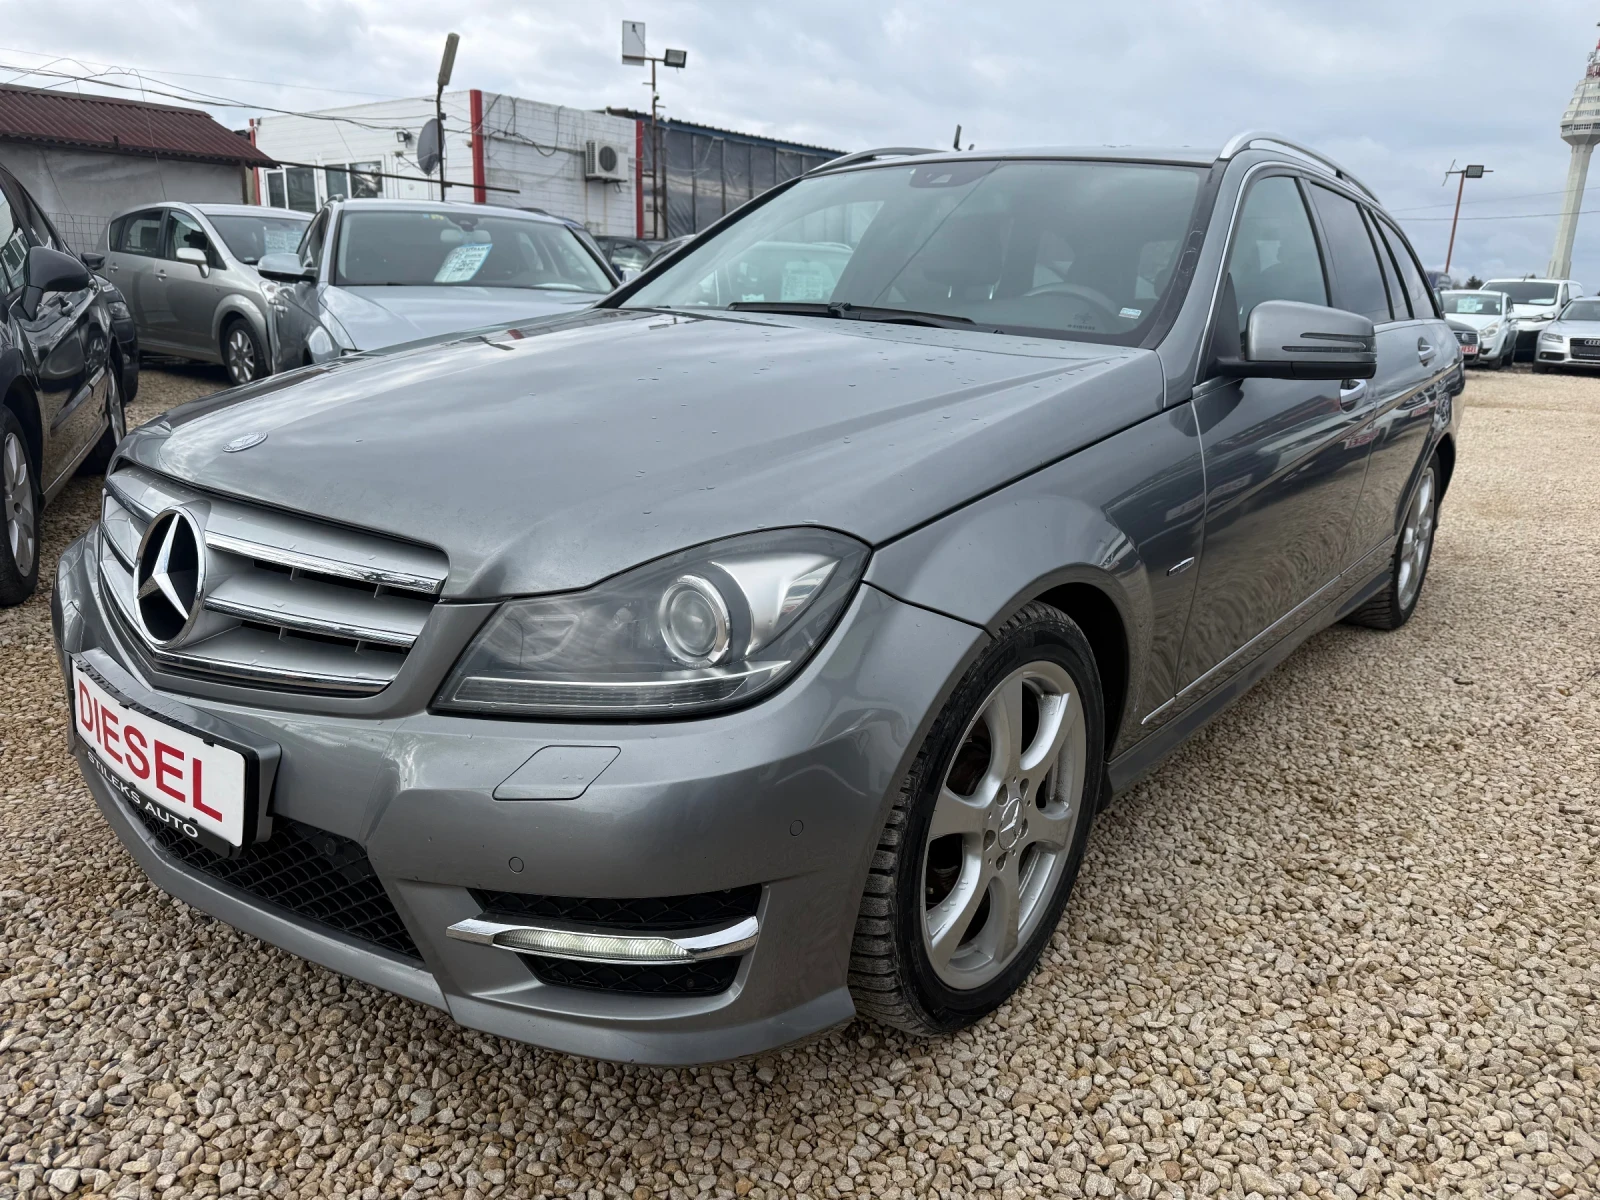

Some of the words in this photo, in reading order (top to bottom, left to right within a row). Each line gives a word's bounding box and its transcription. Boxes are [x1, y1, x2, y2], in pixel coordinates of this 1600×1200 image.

[79, 679, 222, 823] DIESEL
[87, 751, 141, 804] STILEKS
[144, 801, 199, 838] AUTO
